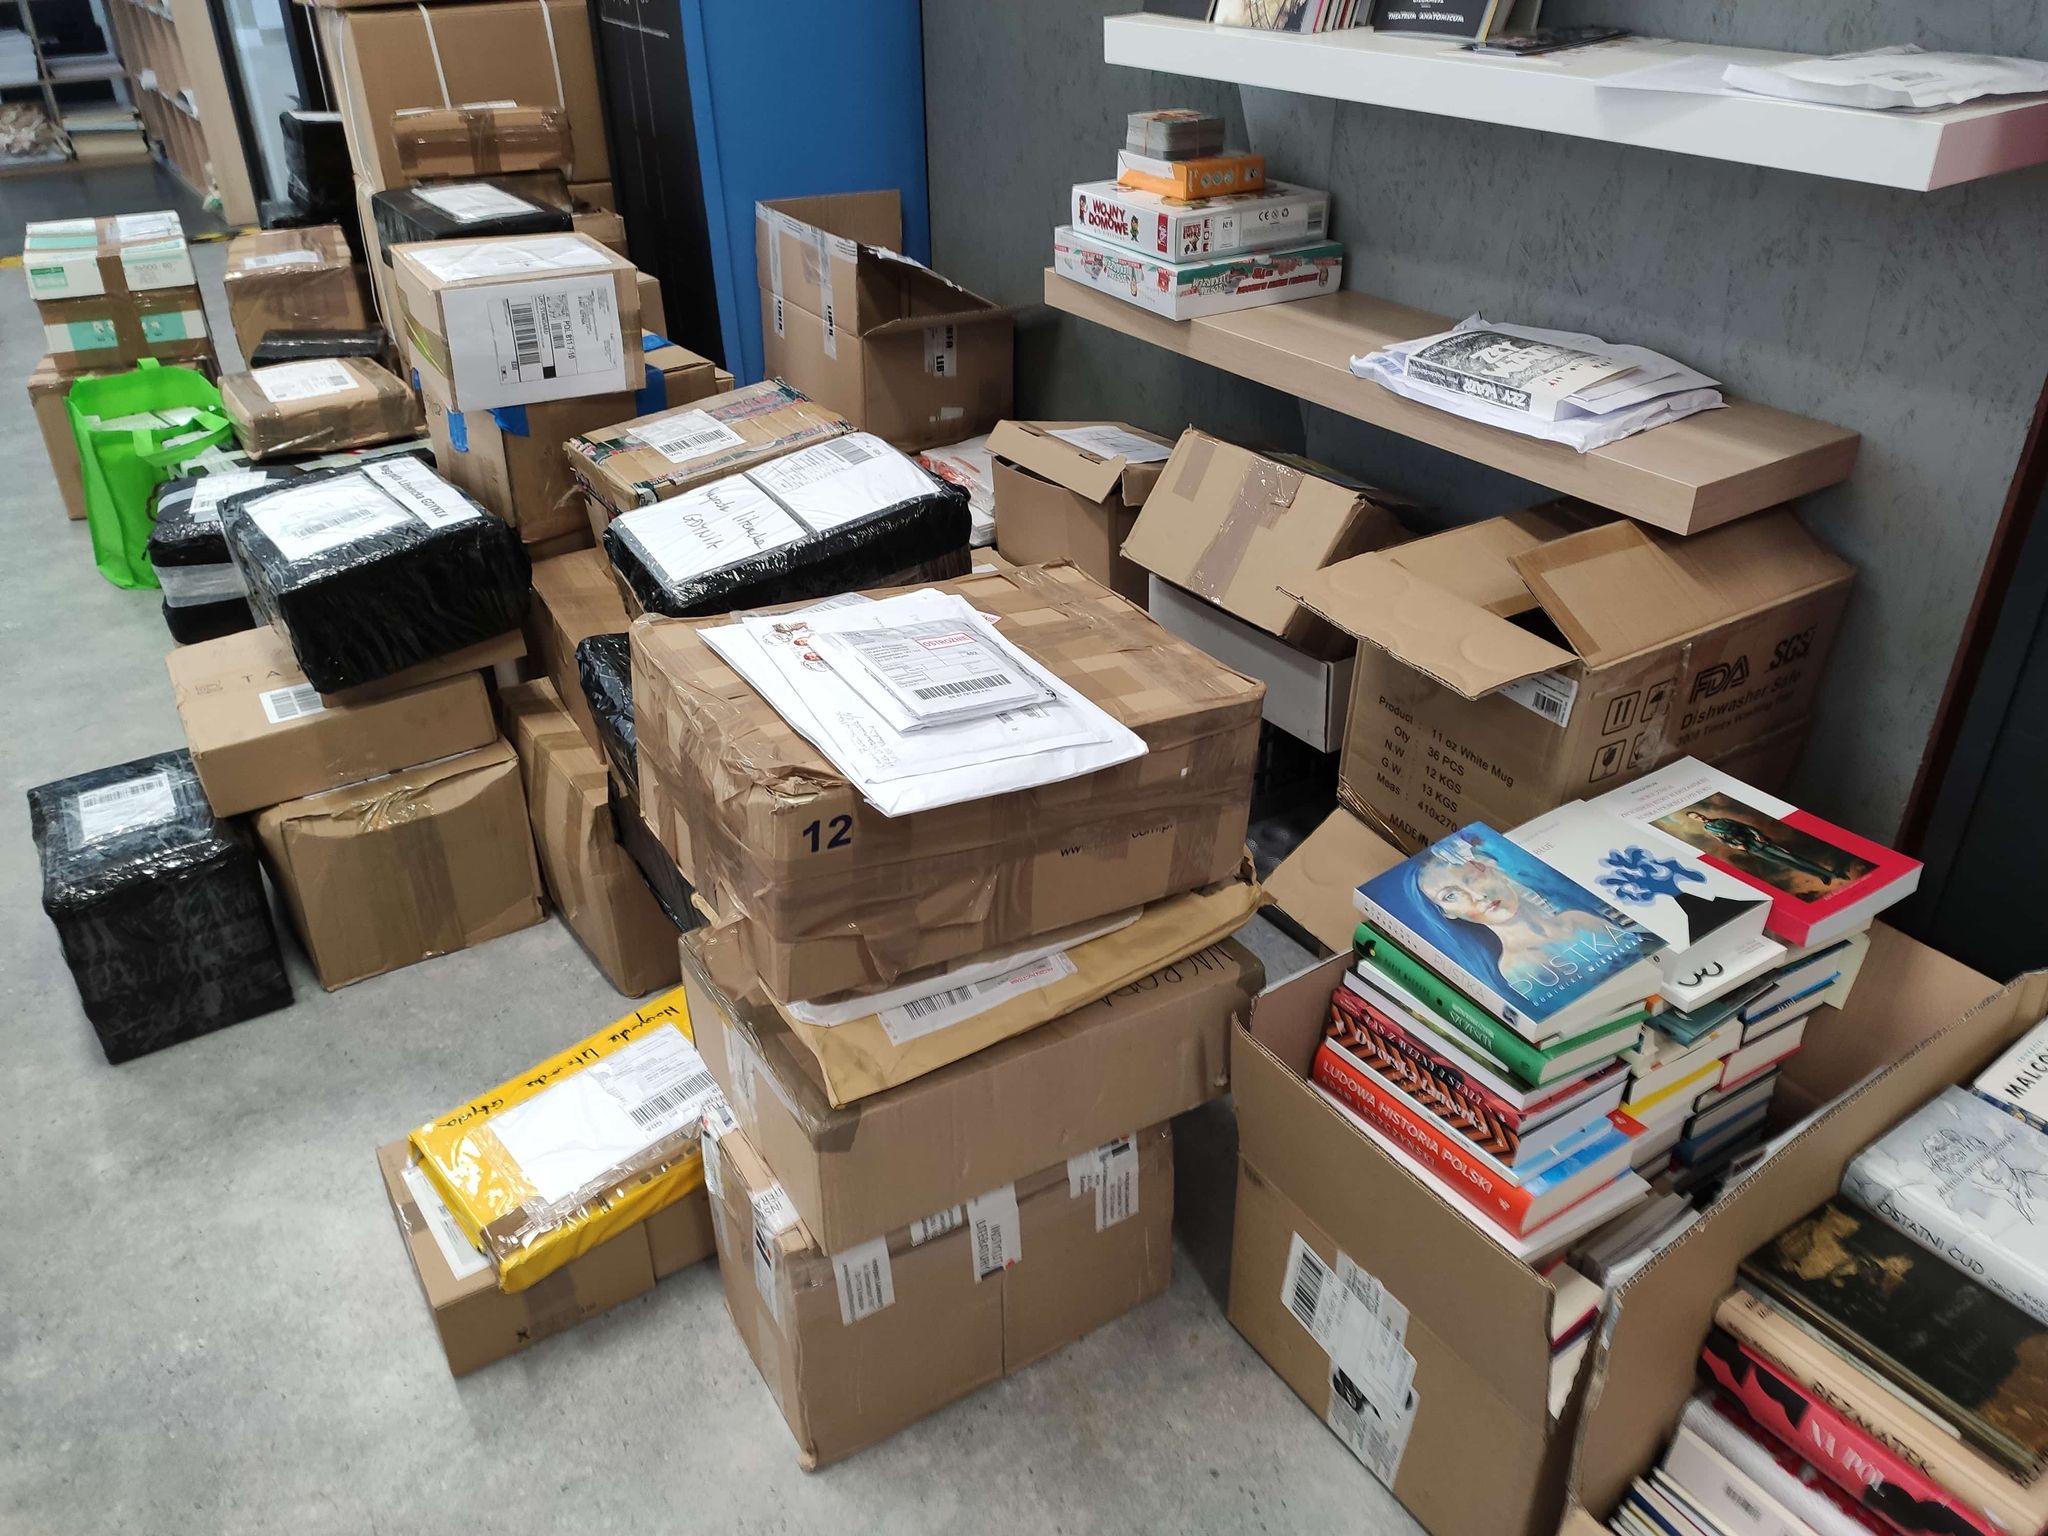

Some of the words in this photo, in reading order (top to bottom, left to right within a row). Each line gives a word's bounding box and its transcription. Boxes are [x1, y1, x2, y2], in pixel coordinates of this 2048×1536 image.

[1388, 11, 1416, 20] THEATRUM
[1419, 12, 1464, 23] ANATOMICUM
[1089, 212, 1129, 236] DOMOWE
[1092, 199, 1126, 222] WOJNY
[420, 497, 449, 518] GDYNIA
[682, 513, 724, 550] GDYNIA
[922, 635, 970, 649] OSTROŻNIE
[1689, 655, 1750, 704] FDA
[1378, 696, 1414, 724] Product
[1432, 728, 1443, 742] 11
[1445, 739, 1457, 752] oz
[1460, 744, 1489, 771] White
[1491, 764, 1514, 788] Mug
[1394, 725, 1411, 744] Qty
[1427, 746, 1440, 761] 36
[1441, 754, 1465, 777] PCS
[1422, 783, 1433, 797] 13
[1434, 791, 1458, 813] KGS
[1425, 765, 1437, 779] 12
[1438, 773, 1462, 796] KGS
[802, 813, 853, 853] 12
[1389, 813, 1418, 840] MADE
[1418, 831, 1429, 847] IN
[1434, 953, 1485, 1000] PUSTKA
[1509, 924, 1654, 1001] PUSTKA
[1448, 1076, 1483, 1105] STALI
[1323, 1060, 1377, 1108] LUDOWA
[1378, 1101, 1439, 1155] HISTORIA
[1441, 1148, 1493, 1194] POLSKI
[1877, 1199, 1945, 1251] OSTATNI
[1948, 1246, 1985, 1275] CUD
[1811, 1380, 1935, 1480] BEZMATEK
